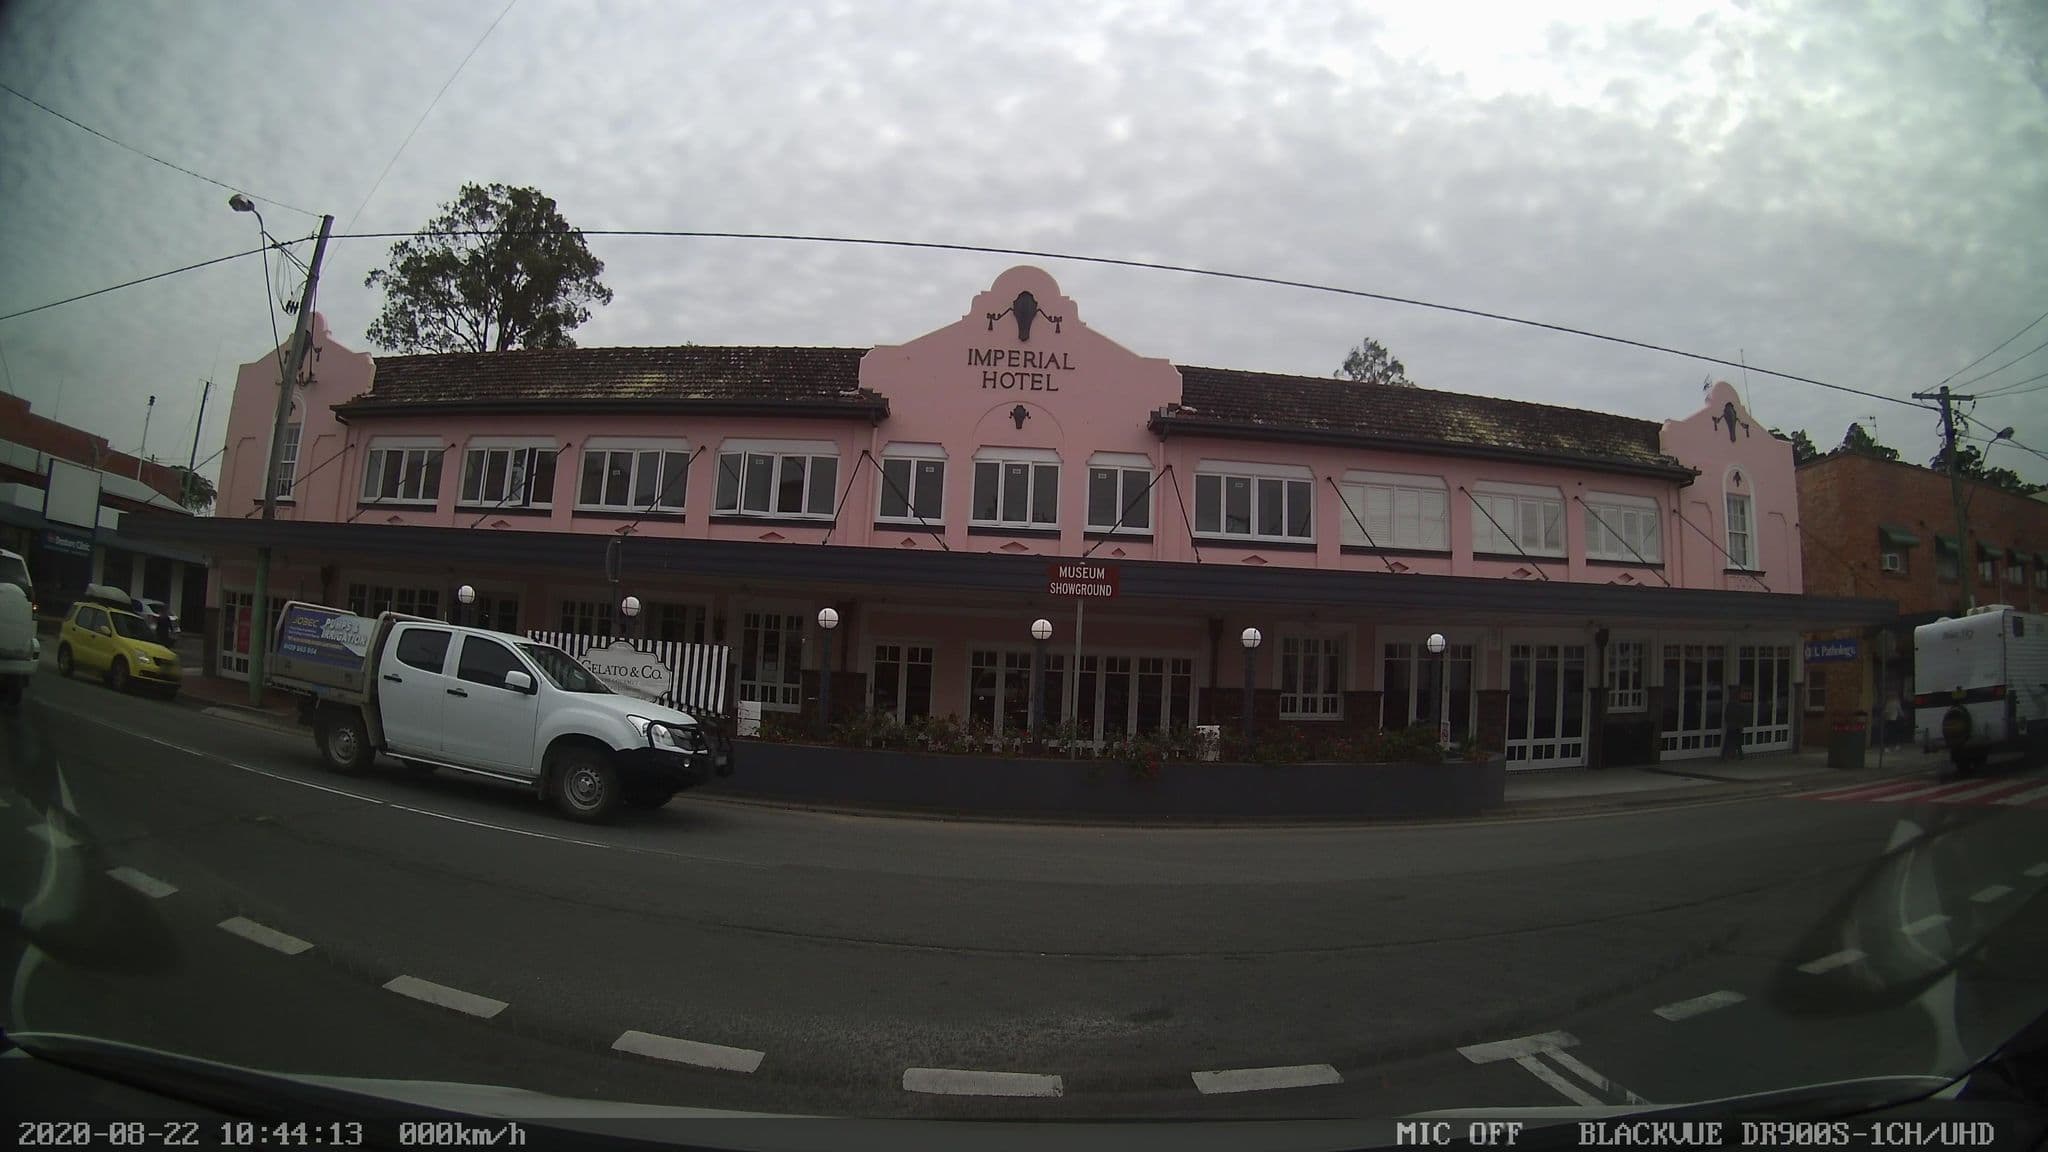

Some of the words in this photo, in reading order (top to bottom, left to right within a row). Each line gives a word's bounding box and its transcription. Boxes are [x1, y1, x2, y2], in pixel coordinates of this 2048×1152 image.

[967, 348, 1076, 370] IMPERIAL
[981, 371, 1059, 392] HOTEL
[1058, 566, 1105, 580] MUSEUM
[1049, 582, 1112, 597] SHOWGROUND
[324, 618, 353, 633] PUMPS
[320, 629, 368, 647] IRRIGATION
[581, 659, 628, 678] GELATO
[629, 666, 641, 678] &
